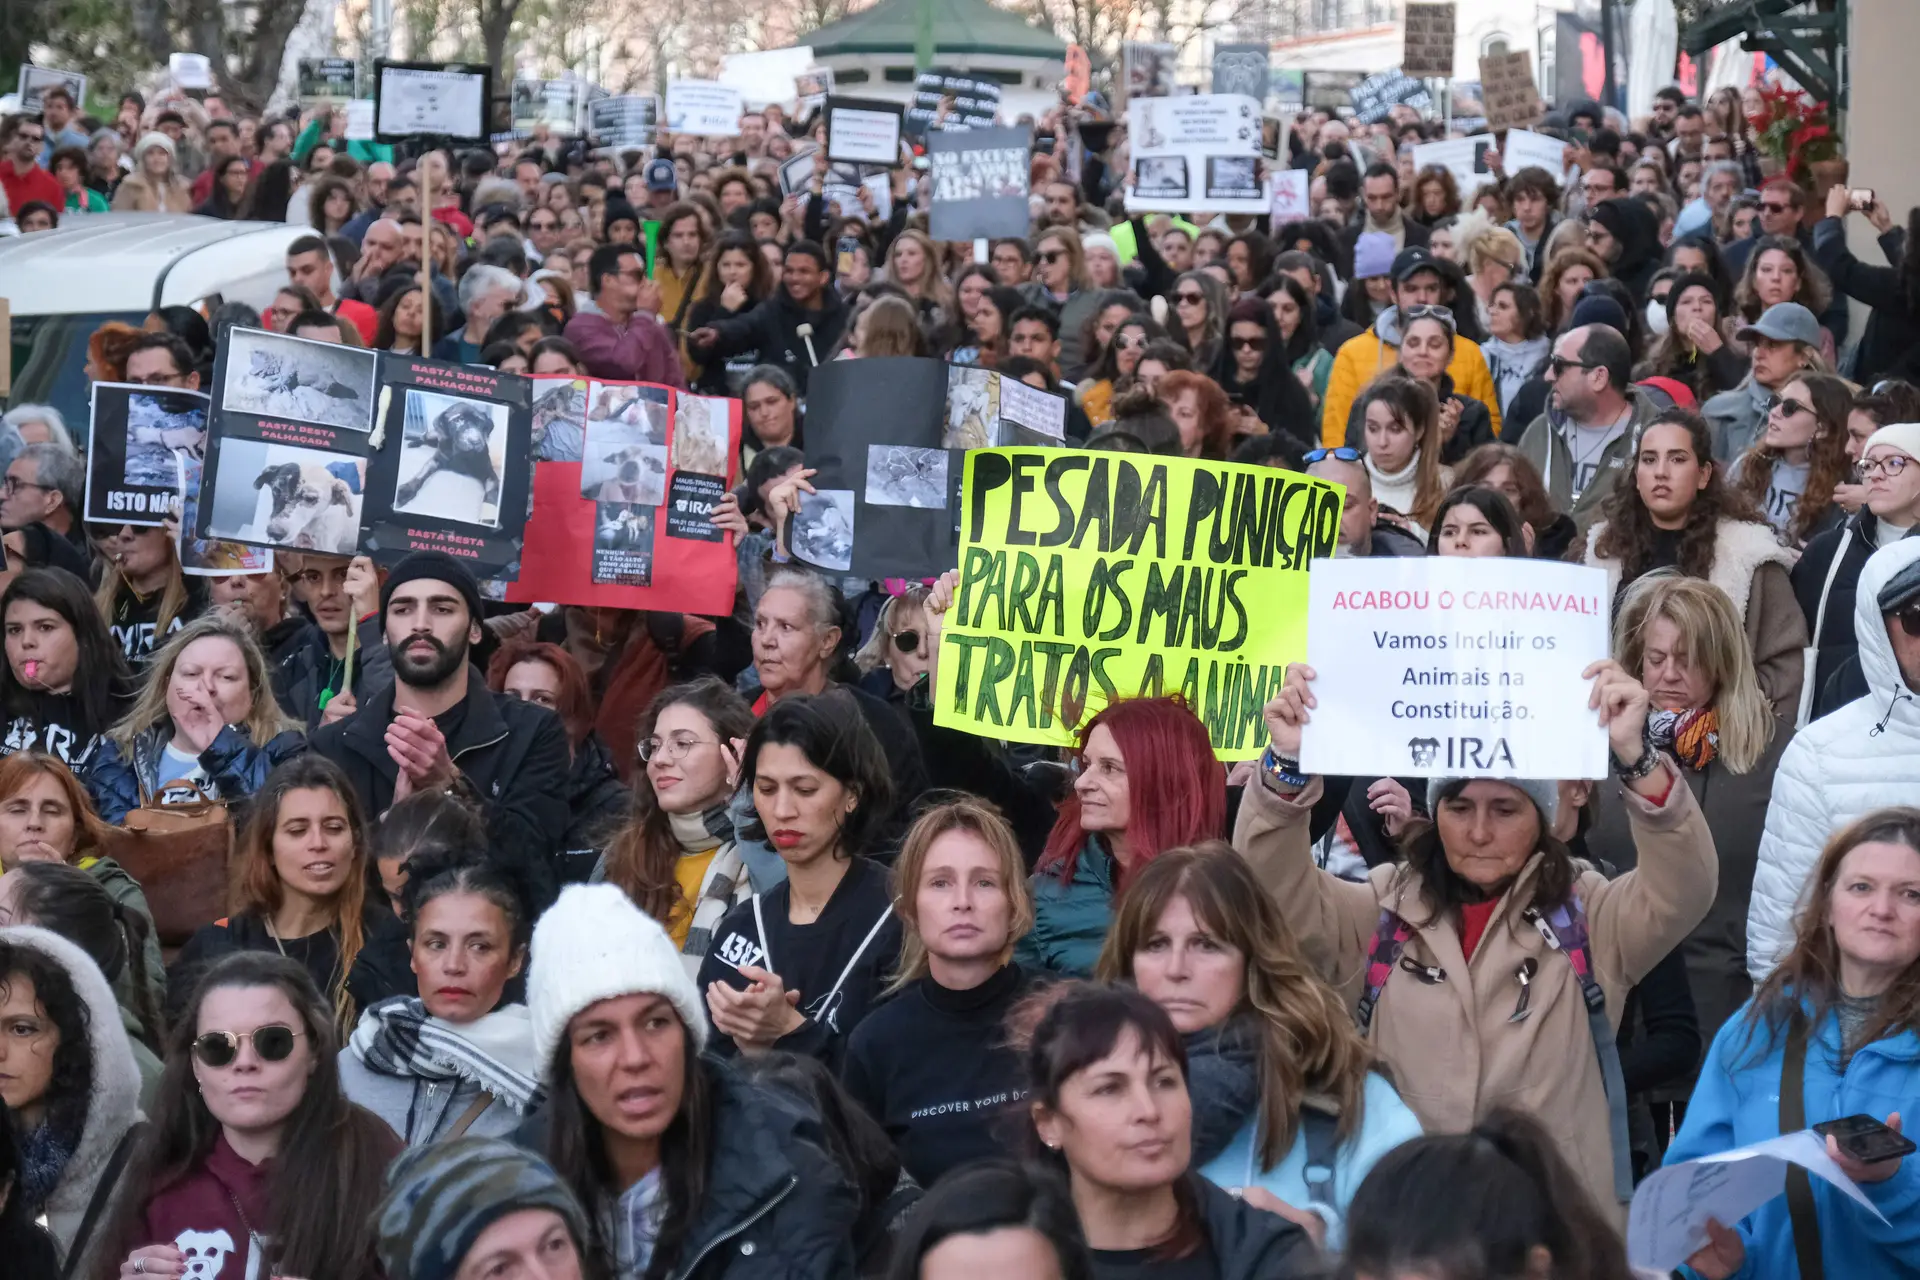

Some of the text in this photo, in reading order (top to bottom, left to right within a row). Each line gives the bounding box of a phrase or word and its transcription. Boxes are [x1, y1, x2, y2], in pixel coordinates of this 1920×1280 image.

[411, 364, 498, 386] BASTA DESTA
[415, 376, 493, 396] PALHAÇADA
[257, 420, 336, 439] BASTA DESTA
[261, 430, 331, 447] PALHAÇADA
[672, 484, 698, 493] ANIMAIS
[698, 487, 712, 495] SEM
[675, 476, 718, 489] MAUS-TRATOS
[107, 490, 147, 512] ISTO
[688, 500, 713, 515] IRA
[669, 517, 680, 525] DIA
[687, 519, 696, 527] DE
[969, 452, 1168, 559] PESADA
[1182, 468, 1340, 572] PUNIÇÃO
[407, 528, 485, 547] BASTA DESTA
[619, 562, 646, 570] AQUELE
[956, 546, 1248, 653] PARA OS MAUS
[1332, 590, 1599, 616] ACABOU O CARNAVAL!
[1373, 630, 1556, 650] Vamos Incluir os
[945, 633, 1122, 731] TRATOS
[1402, 667, 1525, 686] Animais na
[1391, 700, 1536, 723] Constituição.
[1446, 737, 1518, 770] IRA
[911, 1101, 969, 1119] DISCOVER
[974, 1093, 1007, 1109] YOUR
